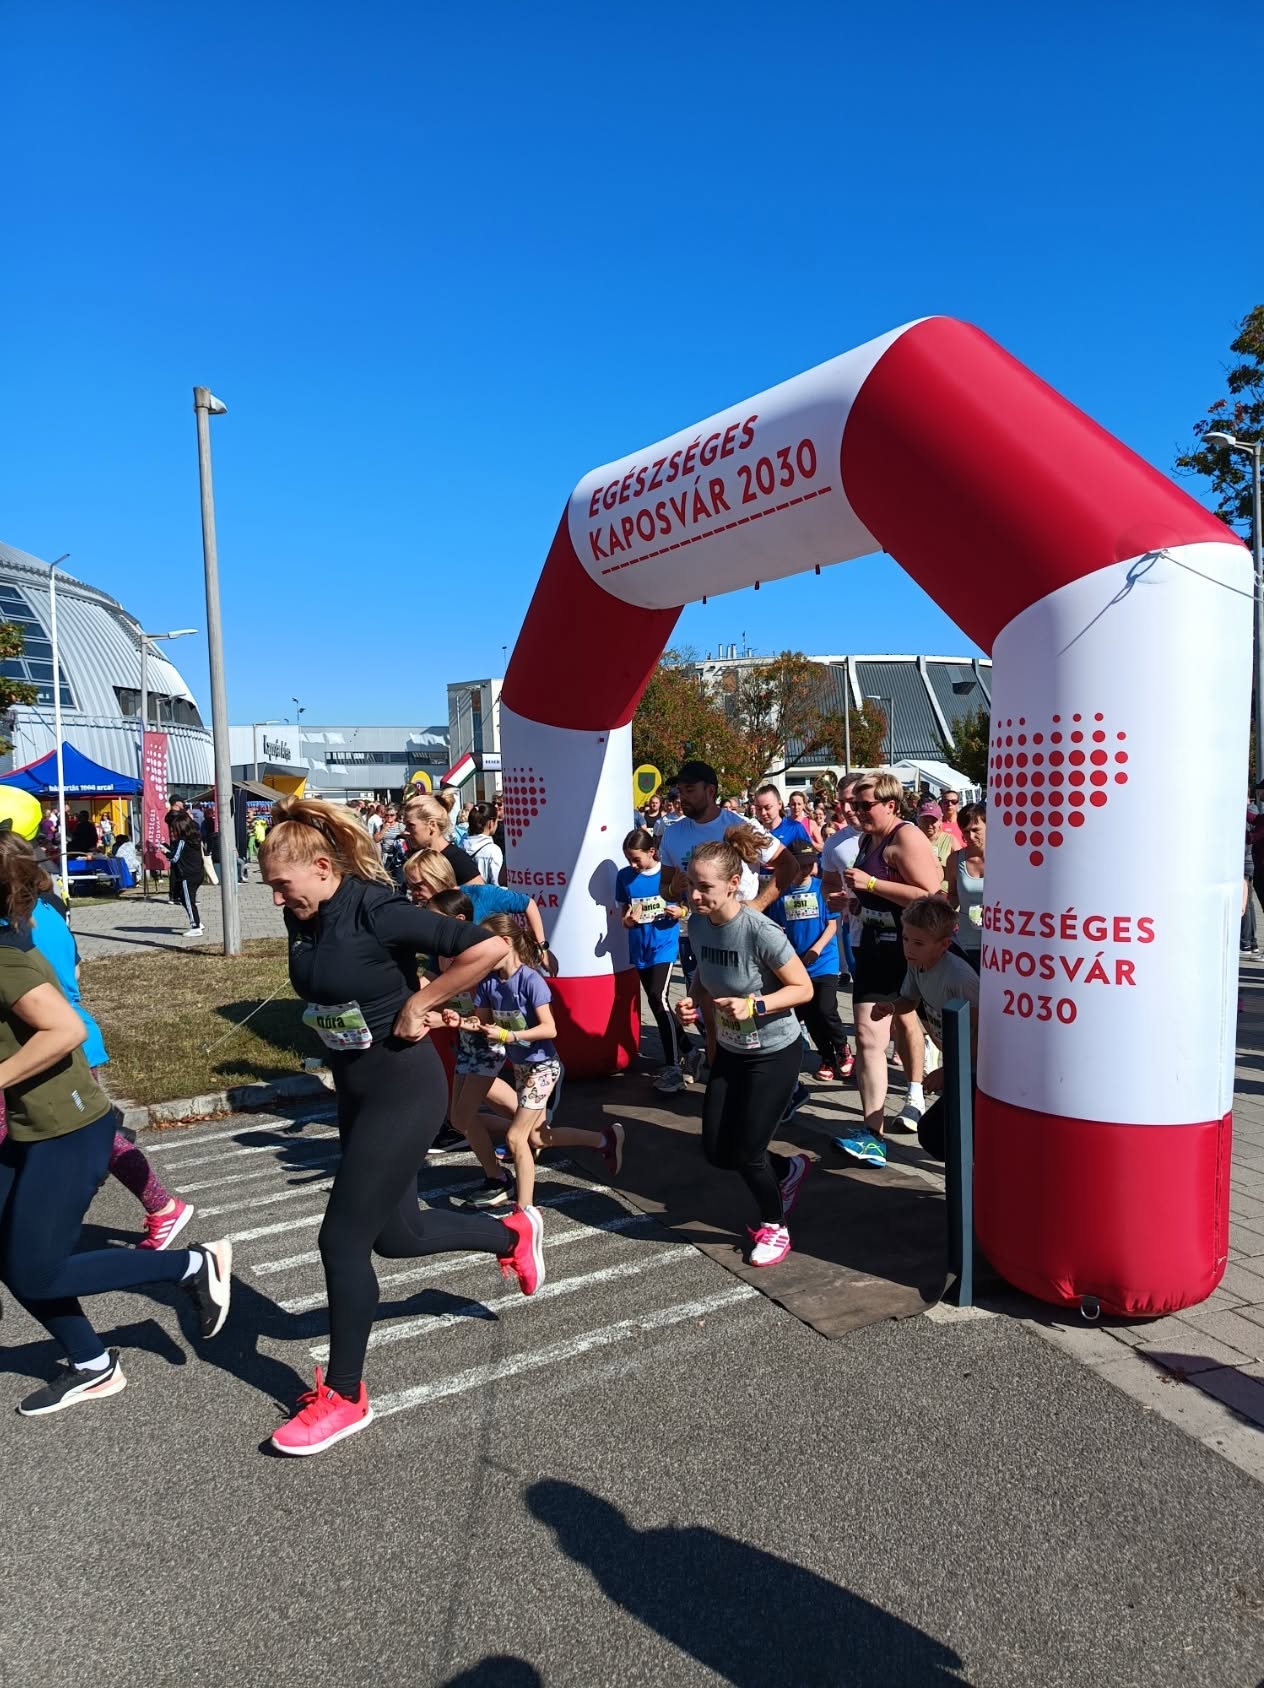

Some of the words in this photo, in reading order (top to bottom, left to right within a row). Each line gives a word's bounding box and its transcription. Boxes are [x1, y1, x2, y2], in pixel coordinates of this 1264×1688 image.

[588, 414, 759, 518] EGÉSZSÉGES
[588, 475, 732, 562] KAPOSVÁR
[737, 438, 817, 505] 2030
[506, 867, 567, 886] SZSÉGES
[982, 943, 1137, 986] KAPOSVÁR
[1002, 989, 1078, 1025] 2030
